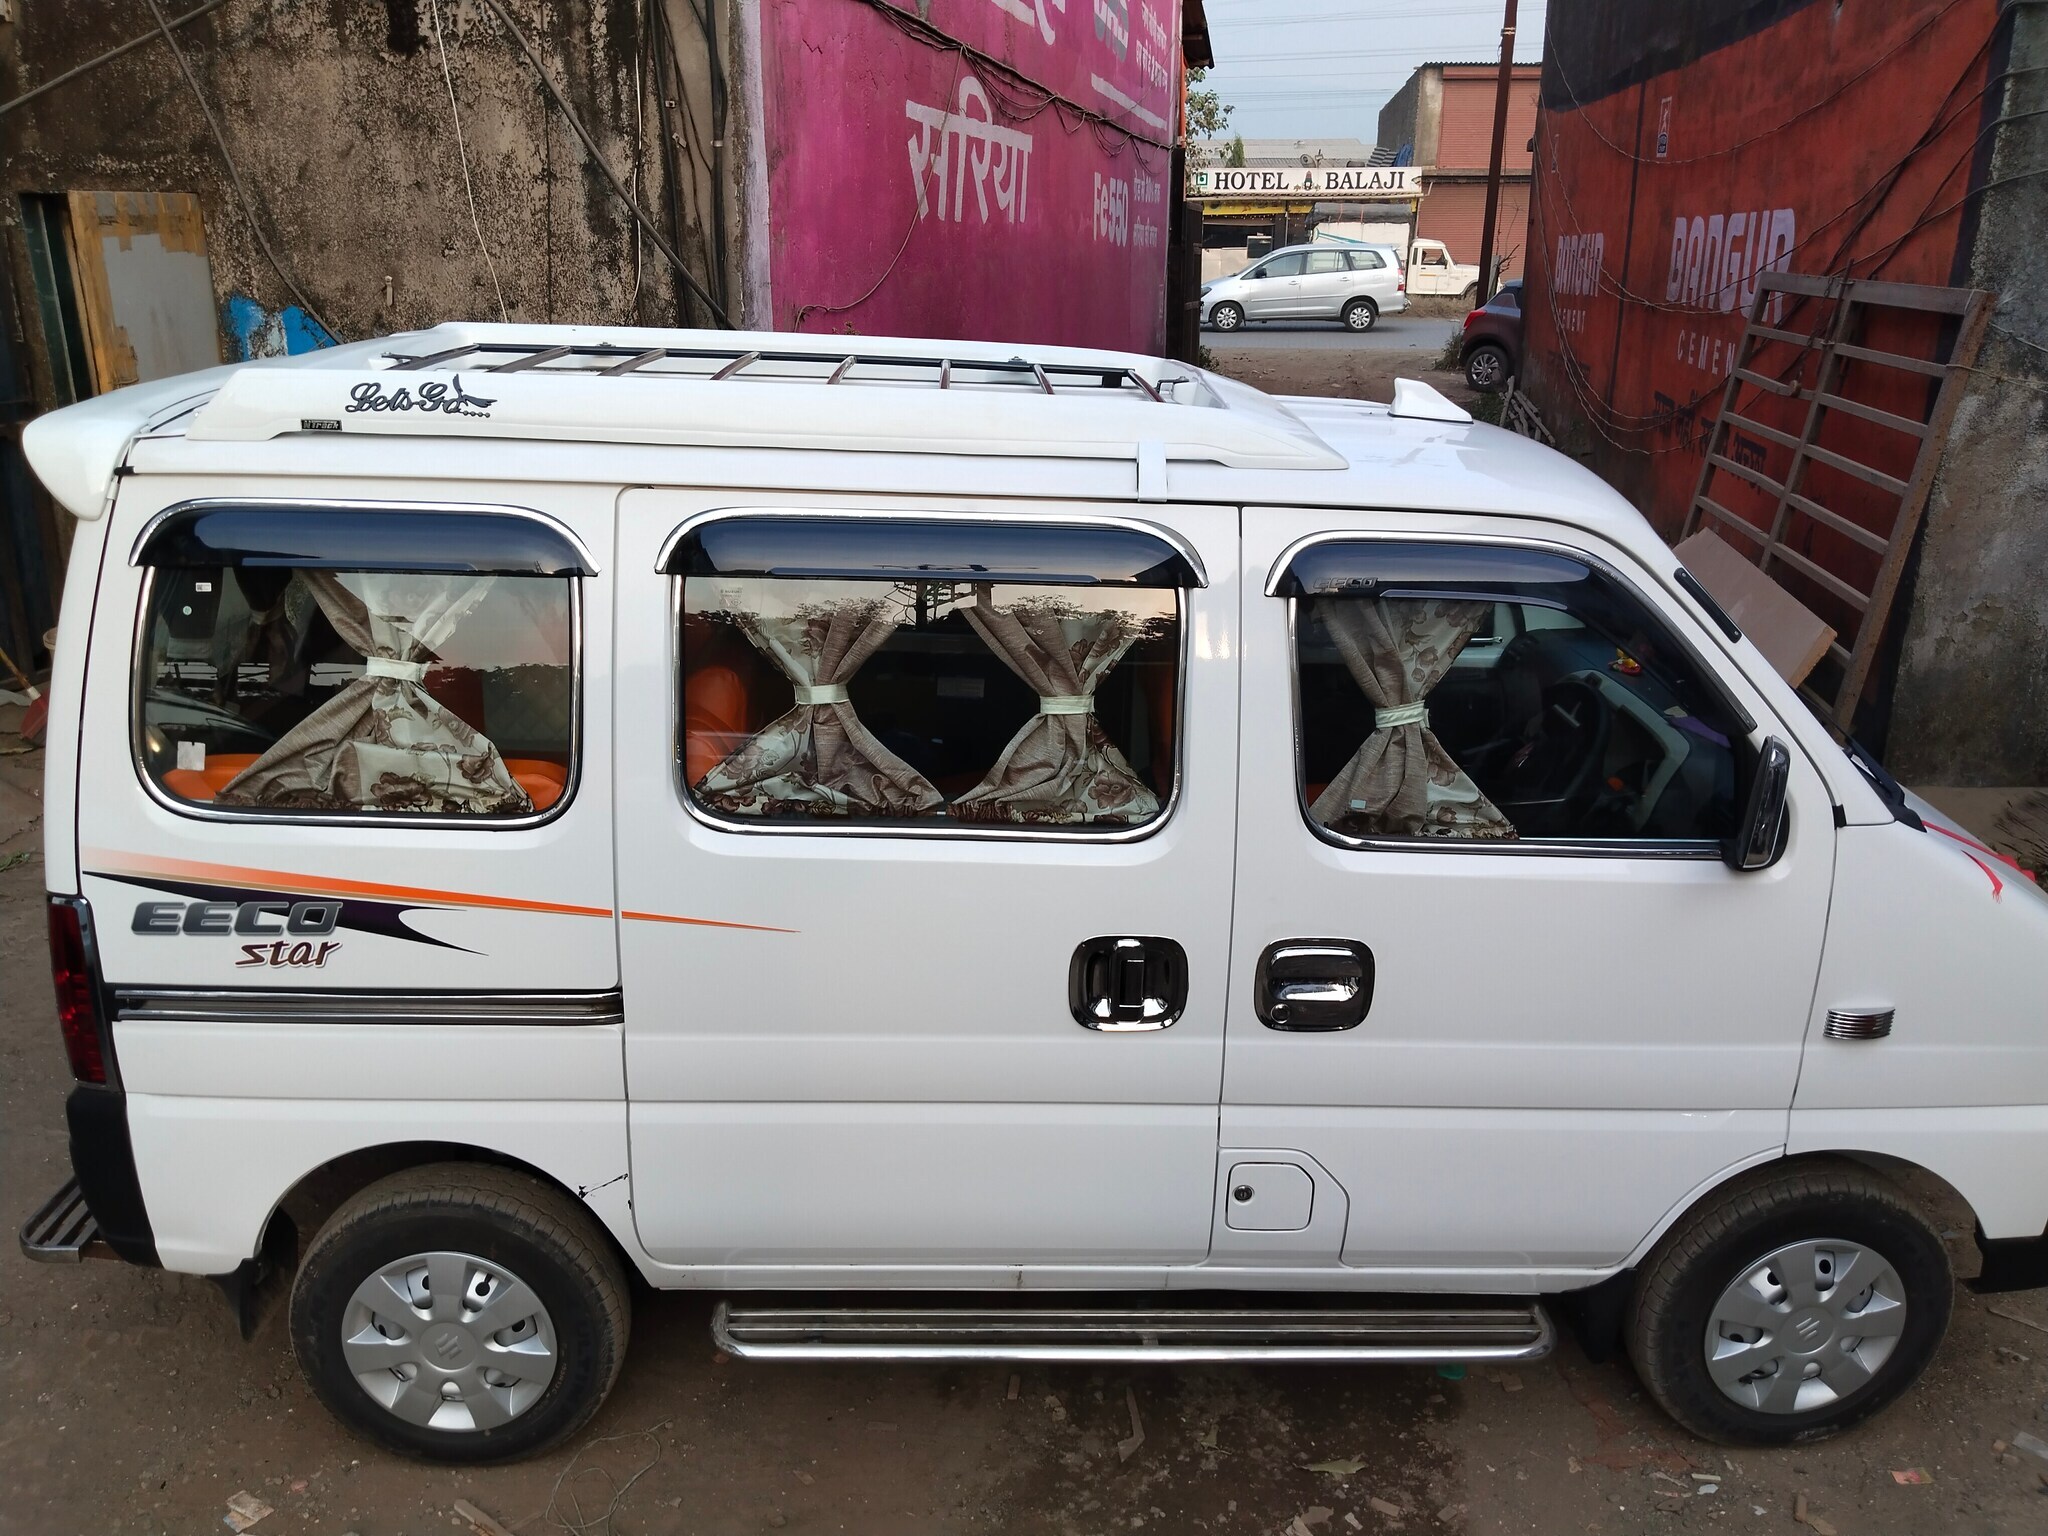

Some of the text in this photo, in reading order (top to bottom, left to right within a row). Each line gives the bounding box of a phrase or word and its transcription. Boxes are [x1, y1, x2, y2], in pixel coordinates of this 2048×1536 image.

[905, 76, 1033, 224] सरिया
[1214, 171, 1405, 190] HOTEL BALAJI
[1553, 232, 1605, 298] BANGUR
[1665, 208, 1796, 324] BANGUR
[1313, 576, 1379, 589] EECO
[131, 902, 344, 936] EECO
[234, 940, 341, 968] star
